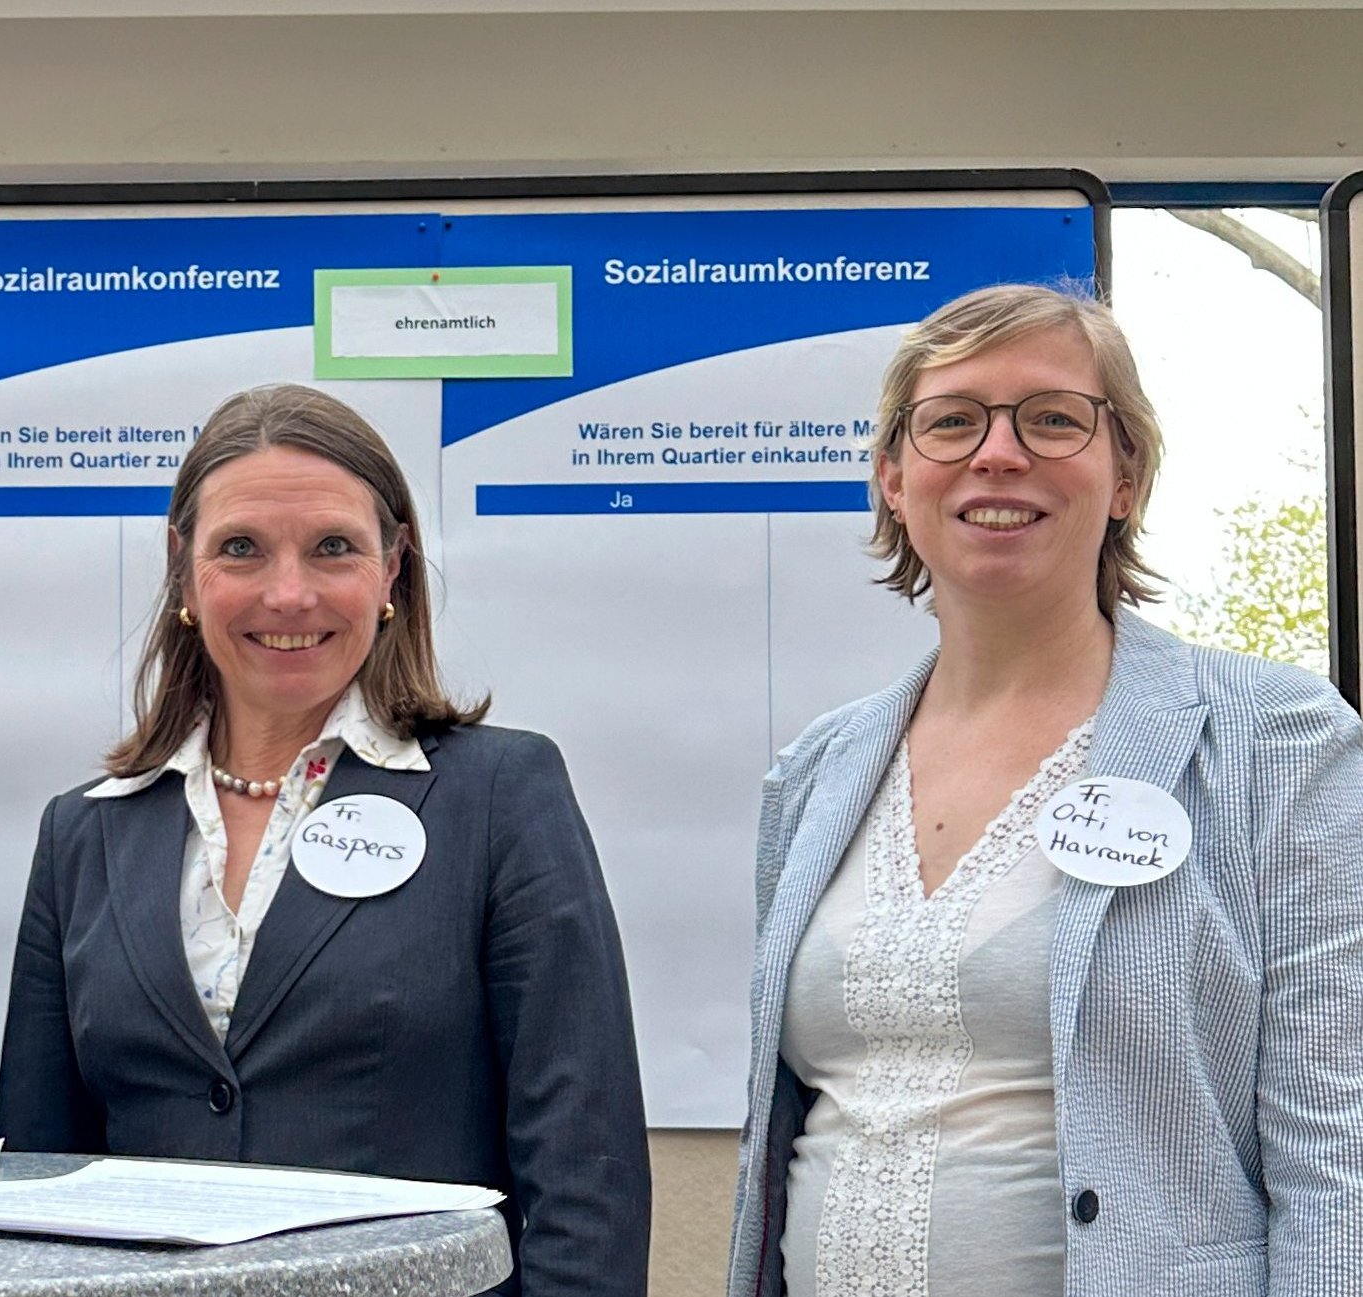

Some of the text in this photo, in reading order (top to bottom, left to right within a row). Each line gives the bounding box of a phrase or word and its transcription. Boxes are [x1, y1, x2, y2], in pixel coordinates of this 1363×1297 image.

[604, 256, 930, 285] Sozialraumkonferenz
[394, 314, 497, 331] ehrenamtlich
[19, 426, 50, 444] Sie
[56, 426, 112, 444] bereit
[118, 425, 186, 443] älteren
[579, 422, 644, 440] Wären
[651, 421, 683, 439] Sie
[690, 421, 748, 439] bereit
[754, 420, 784, 438] für
[789, 419, 847, 438] ältere
[8, 452, 63, 469] Ihrem
[70, 451, 151, 470] Quartier
[156, 455, 180, 468] zu
[572, 449, 590, 466] in
[598, 448, 655, 466] Ihrem
[661, 447, 744, 466] Quartier
[751, 445, 852, 464] einkaufen
[610, 491, 634, 509] Ja
[1078, 784, 1112, 807] Fr.
[1053, 803, 1170, 848] Orti von
[302, 822, 406, 862] Gaspers
[1050, 831, 1164, 868] Havranek
